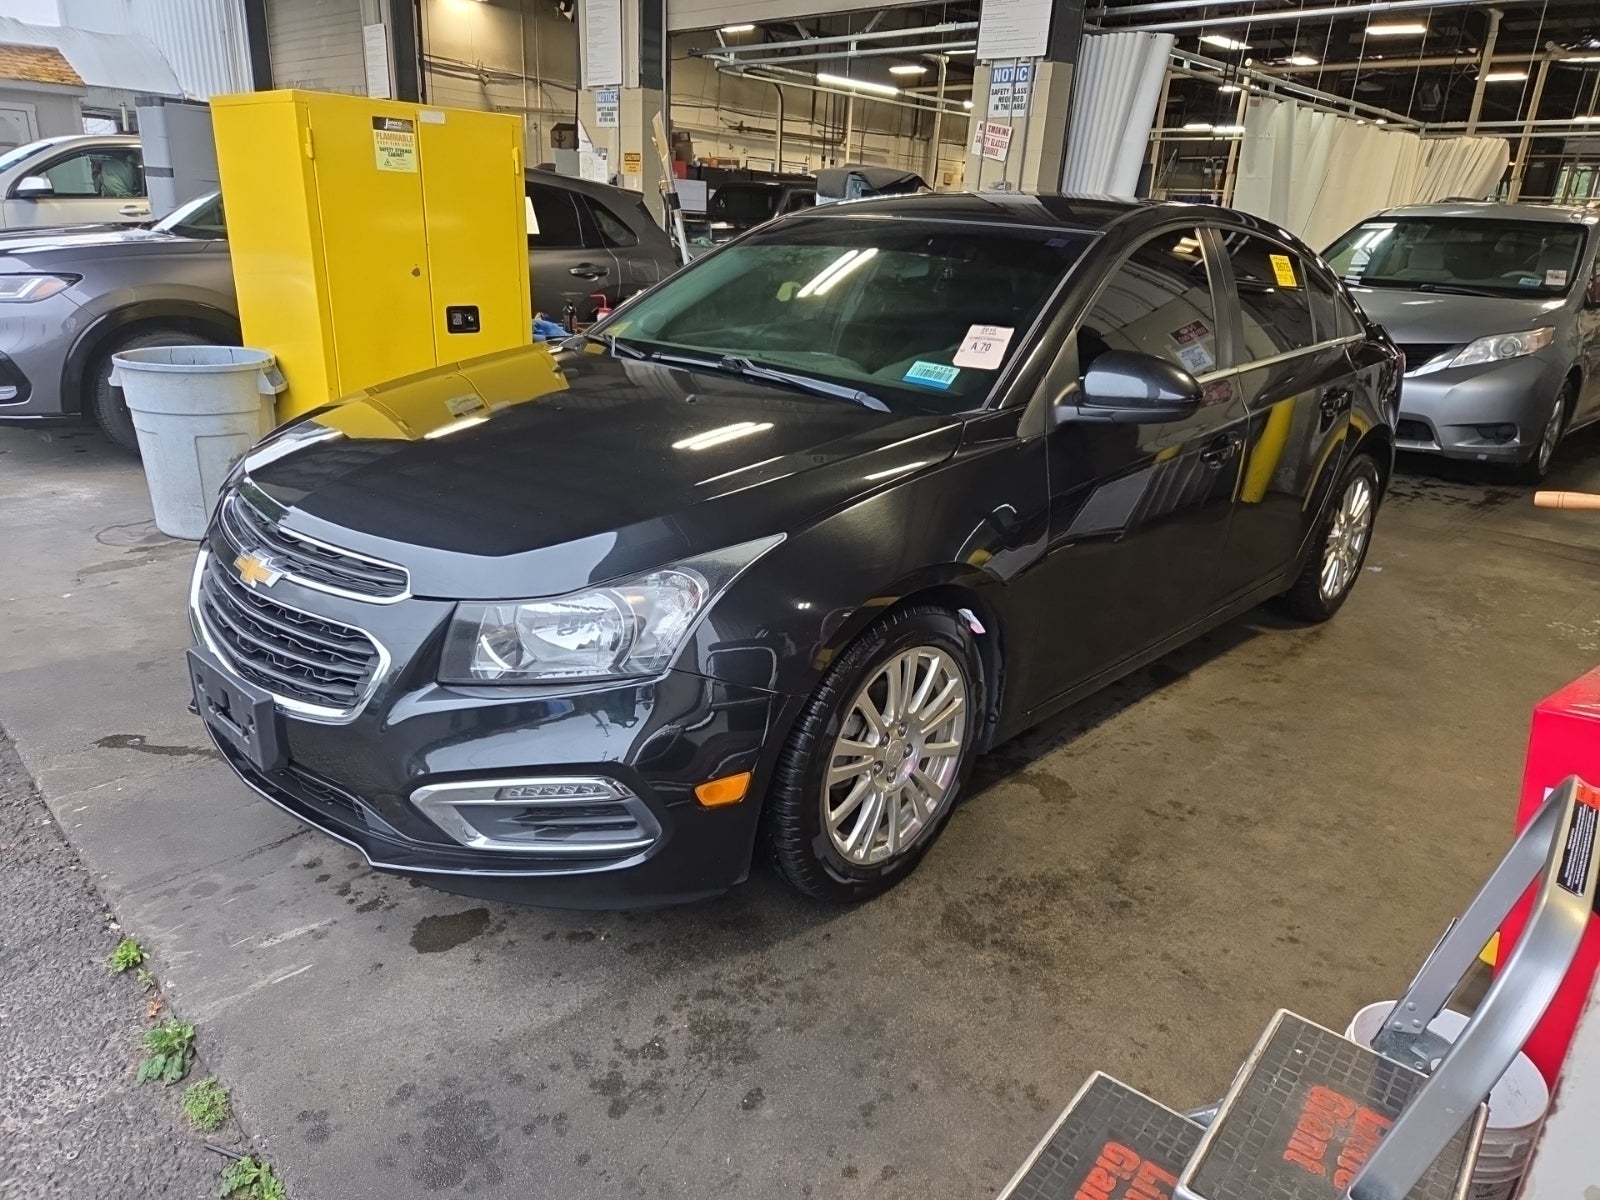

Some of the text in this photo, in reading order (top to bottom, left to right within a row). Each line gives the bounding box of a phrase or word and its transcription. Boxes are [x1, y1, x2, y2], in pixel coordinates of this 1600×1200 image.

[993, 67, 1028, 83] NOTIC
[597, 92, 618, 102] NOTICE
[987, 124, 1010, 137] SMOKING
[376, 132, 414, 143] FLAMMABLE
[970, 342, 991, 352] A 70
[1283, 1085, 1355, 1177] Giant
[1073, 1141, 1140, 1200] Gian
